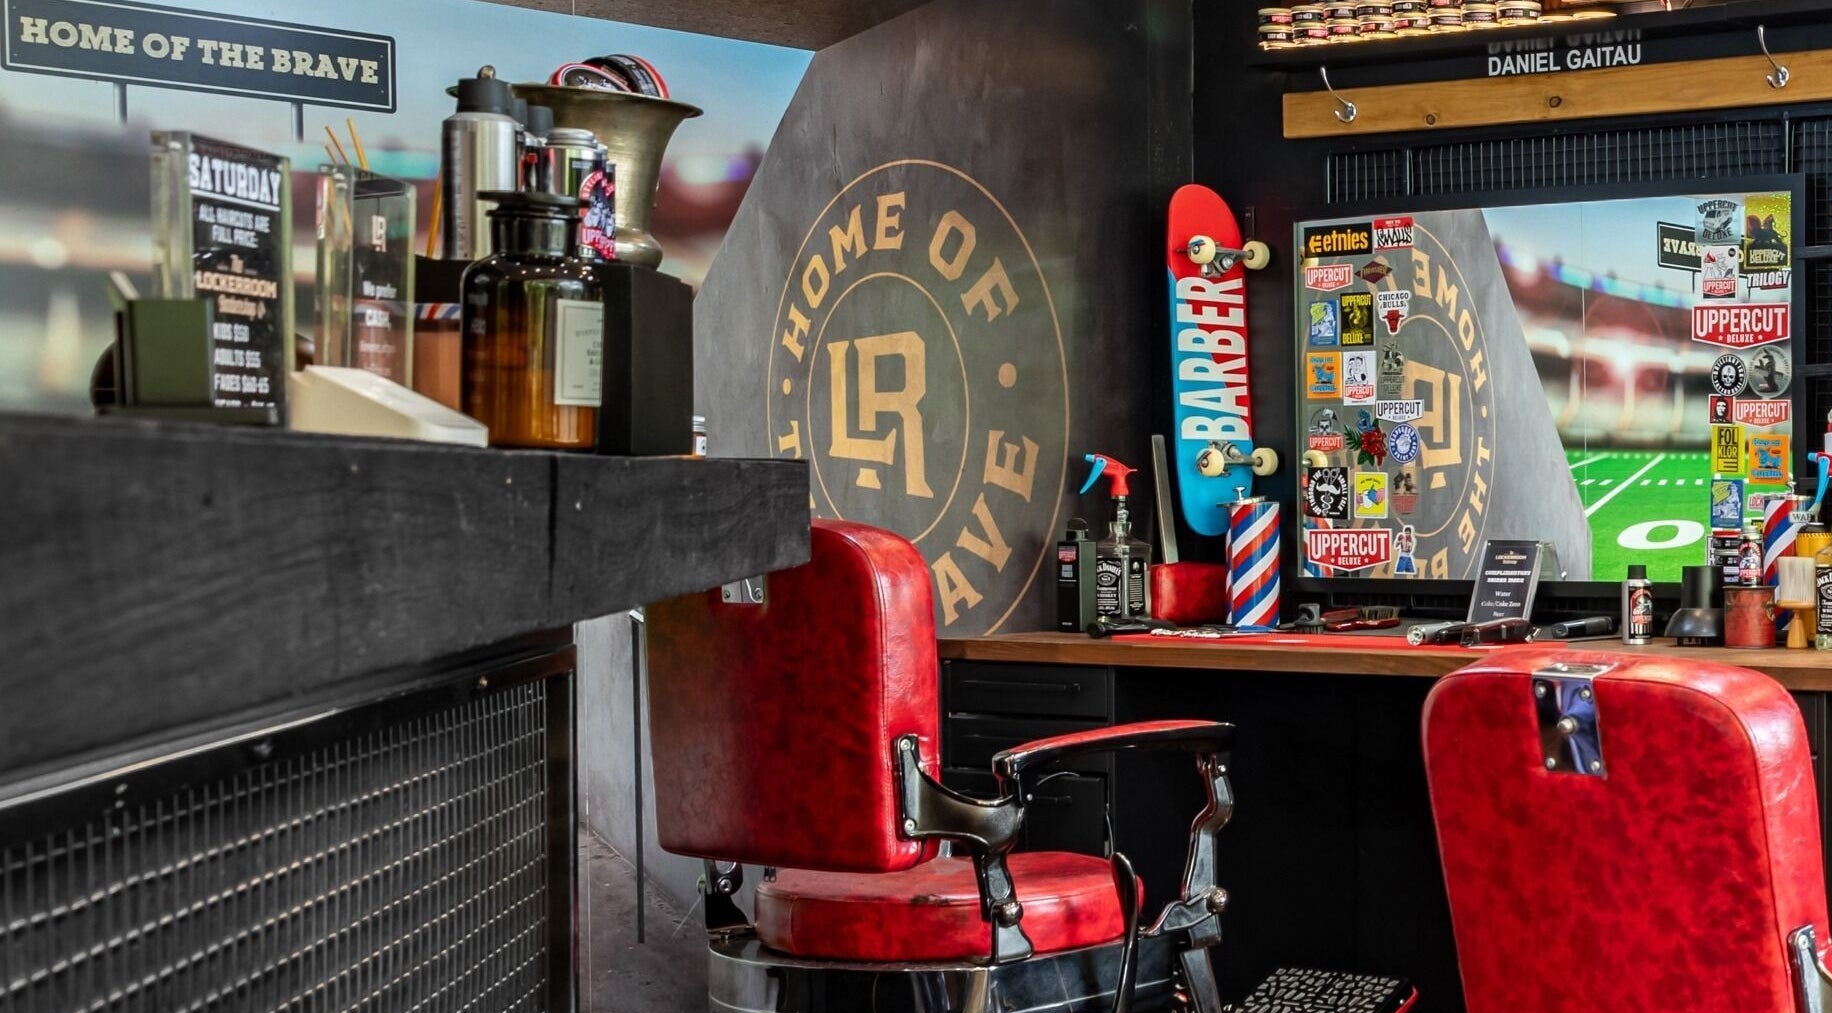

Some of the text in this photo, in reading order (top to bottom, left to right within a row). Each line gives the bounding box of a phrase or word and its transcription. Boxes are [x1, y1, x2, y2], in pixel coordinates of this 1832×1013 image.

[20, 16, 379, 84] HOME OF THE BRAVE
[1489, 44, 1642, 77] DANIEL GAITAU
[188, 153, 281, 205] SATURDAY
[1698, 200, 1739, 214] UPPERCUT
[1323, 229, 1369, 252] etnies
[196, 270, 278, 299] LOCKERROOM
[782, 191, 1020, 364] HOME OF
[1307, 267, 1350, 286] UPPERCUT
[1746, 271, 1791, 288] TRILOGY
[1703, 281, 1735, 291] UPPERCUT
[1342, 295, 1372, 307] UPPERCUT
[1378, 293, 1409, 302] CHICAGO
[1382, 301, 1405, 309] BULLS
[1696, 307, 1786, 337] UPPERCUT
[1342, 332, 1364, 344] DELUXE
[1727, 333, 1754, 343] DELUXE
[1176, 276, 1250, 441] BARBER
[1345, 386, 1374, 397] UPPERCUT
[1377, 401, 1421, 417] UPPERCUT
[1736, 402, 1787, 420] UPPERCUT
[1310, 436, 1342, 448] UPPERCUT
[1719, 428, 1737, 445] FOL
[1718, 445, 1738, 458] KLOR
[1311, 533, 1388, 559] UPPERCUT
[1338, 557, 1361, 566] DELUXE
[1495, 590, 1512, 598] Water
